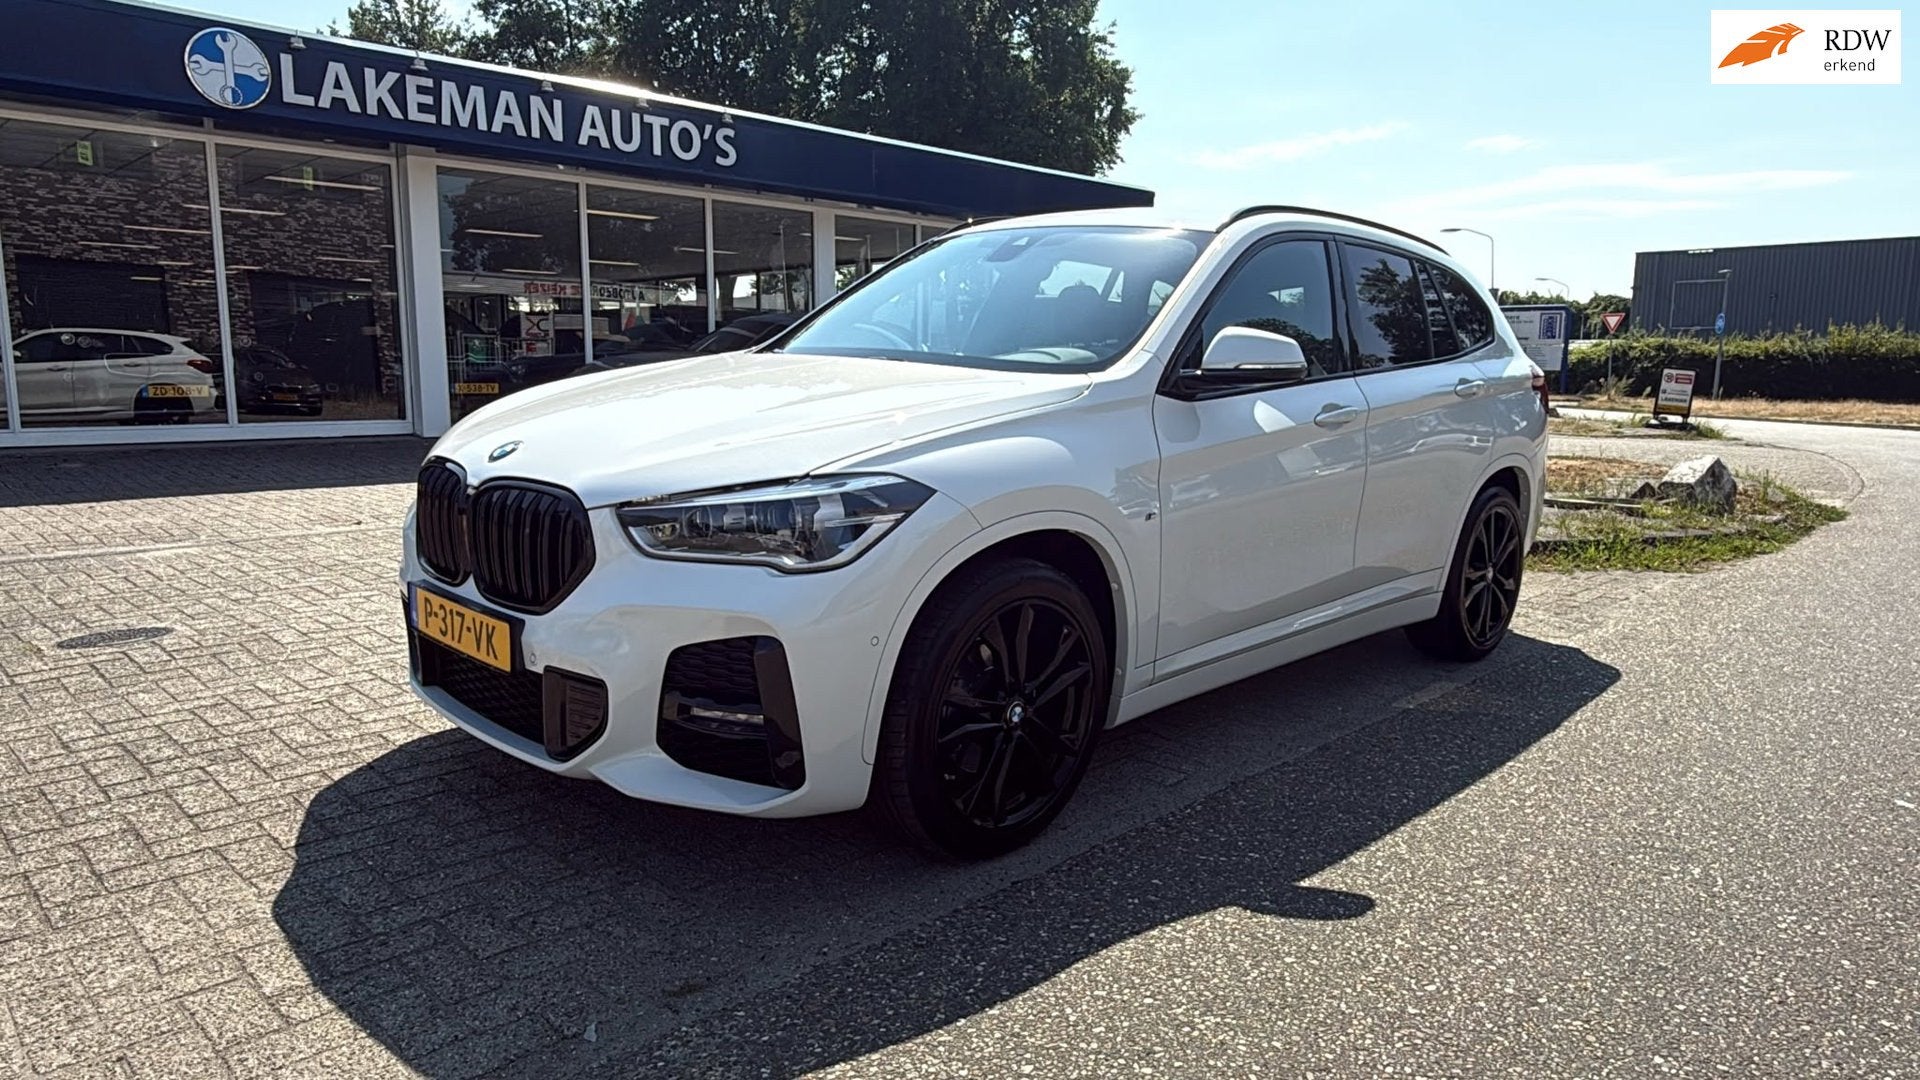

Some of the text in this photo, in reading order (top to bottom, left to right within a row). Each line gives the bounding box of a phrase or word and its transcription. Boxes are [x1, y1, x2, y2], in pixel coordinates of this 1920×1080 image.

[279, 53, 738, 167] LAKEMAN AUTO'S
[423, 596, 499, 661] P-317-VK
